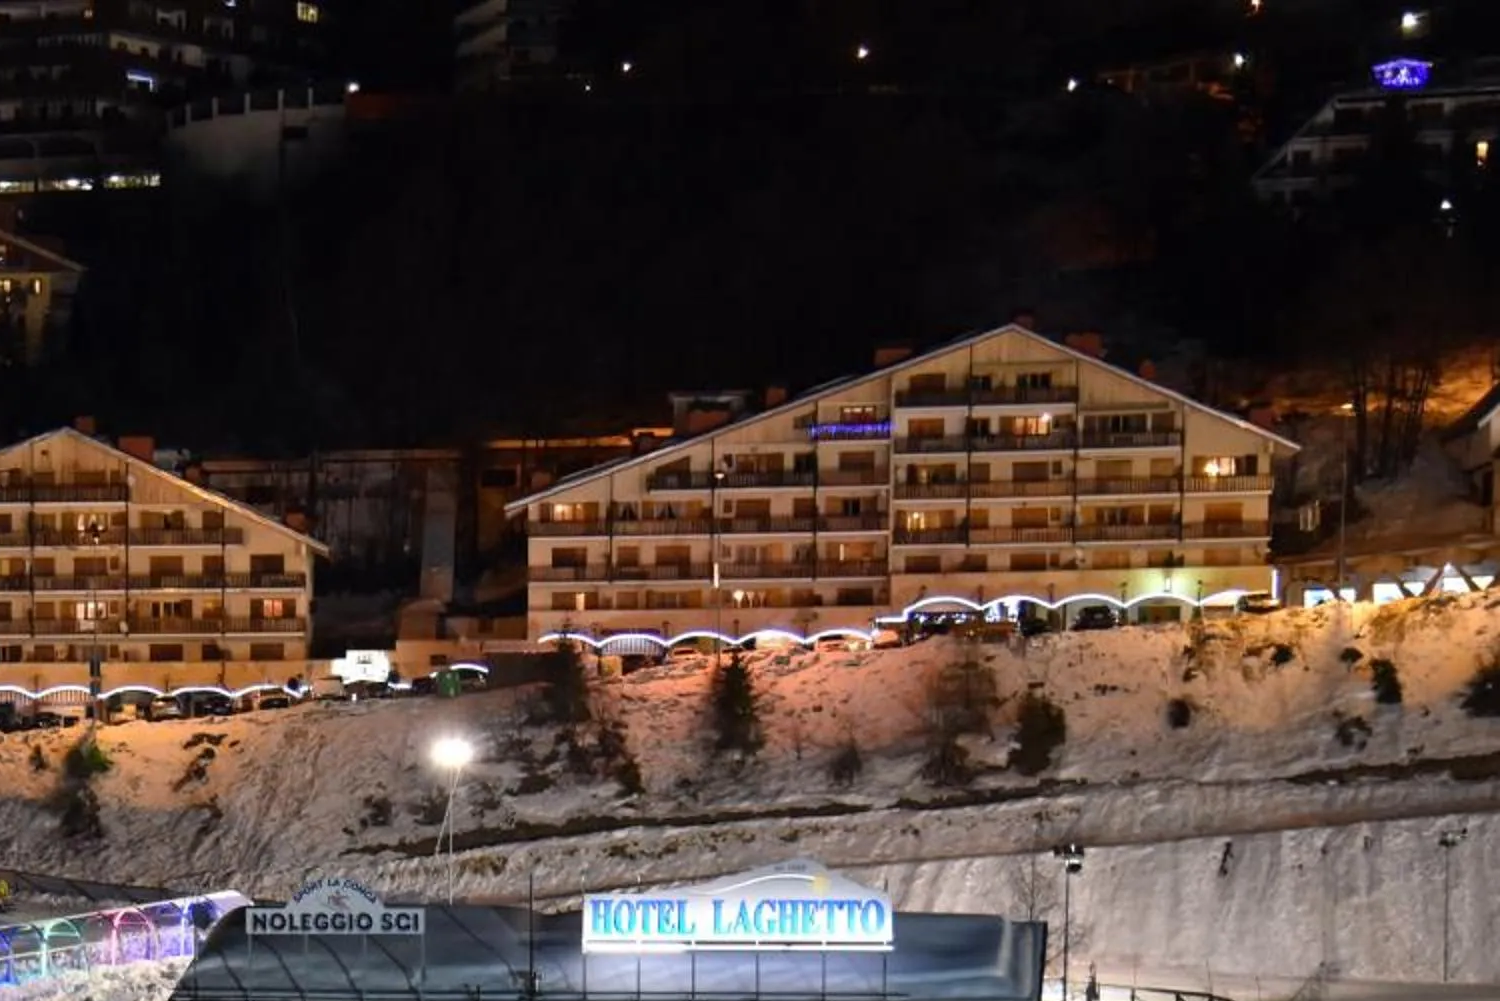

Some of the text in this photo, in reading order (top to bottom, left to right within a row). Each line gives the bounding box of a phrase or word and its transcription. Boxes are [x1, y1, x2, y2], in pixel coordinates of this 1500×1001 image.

[252, 912, 419, 932] NOLEGGIO SCI
[589, 898, 887, 936] HOTEL LAGHETTO
